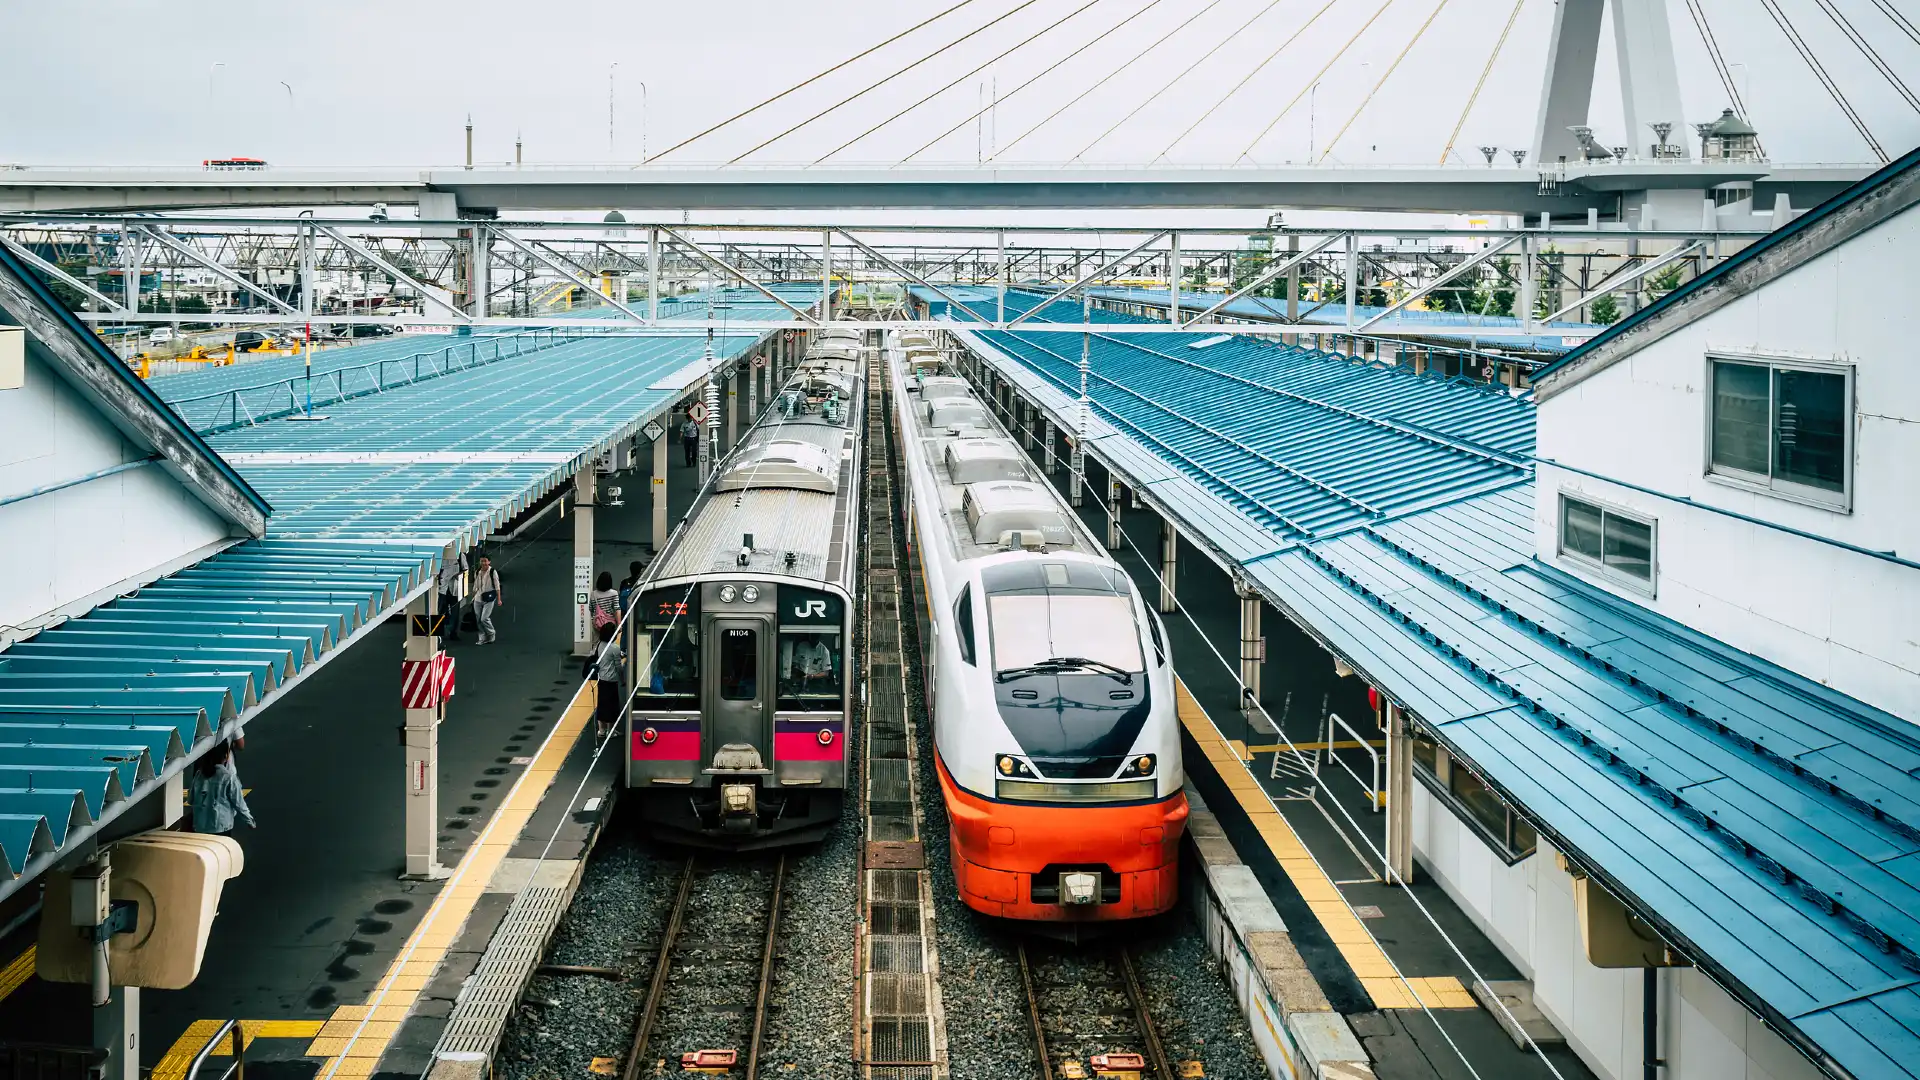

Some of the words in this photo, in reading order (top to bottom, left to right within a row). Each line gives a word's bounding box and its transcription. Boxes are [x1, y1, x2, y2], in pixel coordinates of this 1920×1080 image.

[755, 357, 762, 365] 2
[1486, 368, 1492, 376] 2
[794, 600, 827, 618] JR
[729, 629, 749, 637] N104
